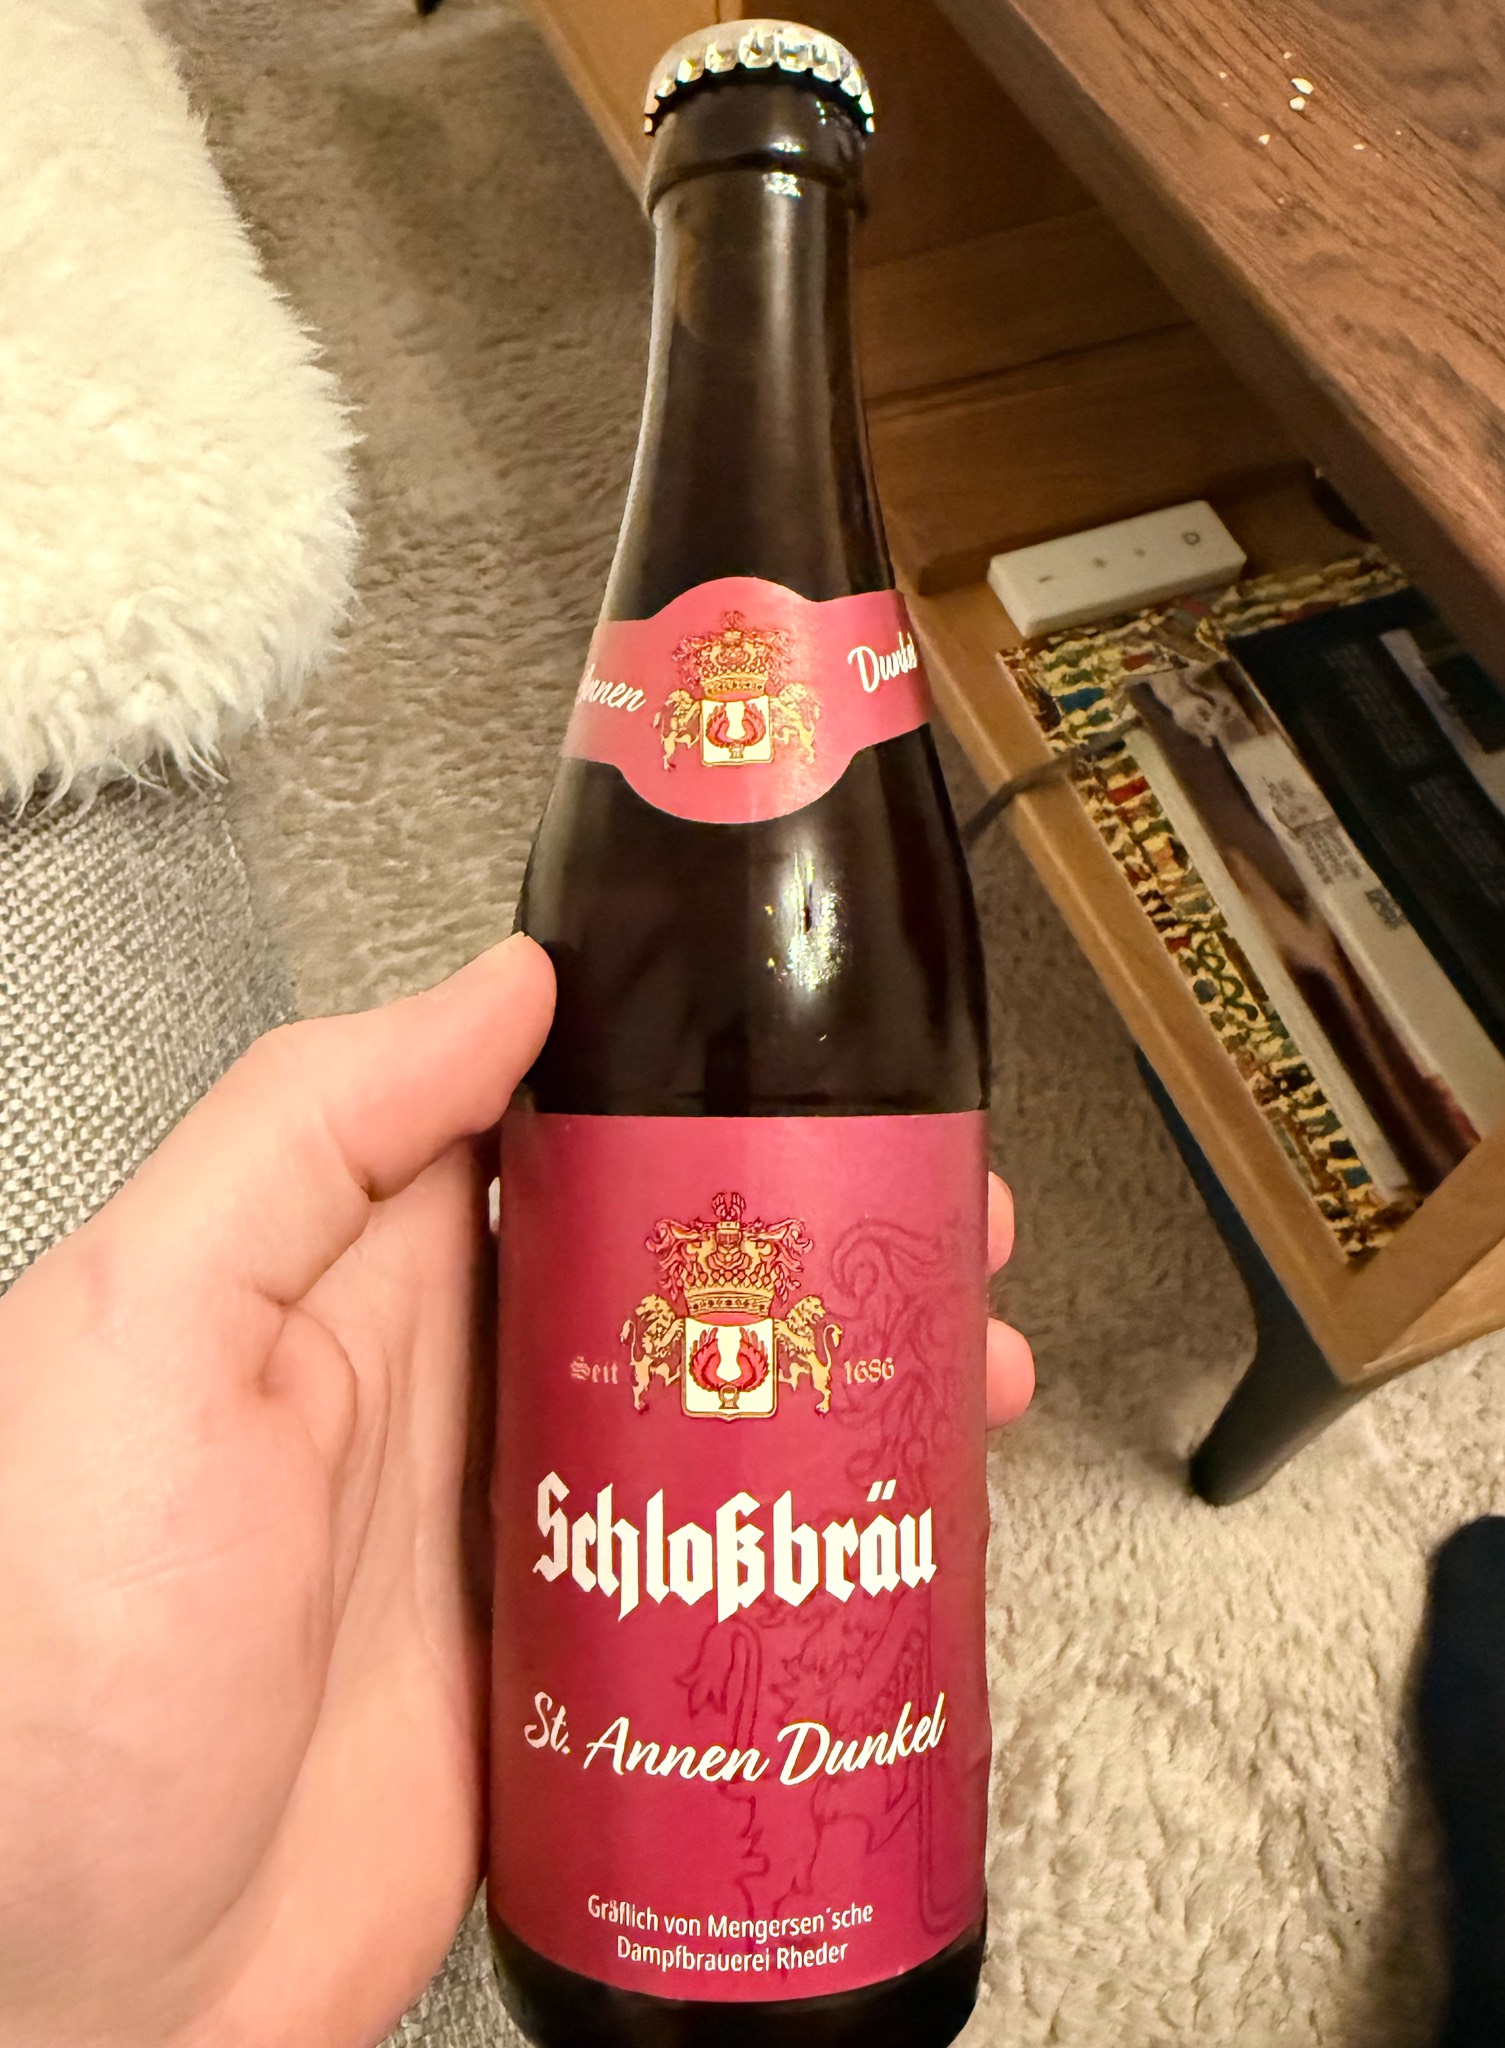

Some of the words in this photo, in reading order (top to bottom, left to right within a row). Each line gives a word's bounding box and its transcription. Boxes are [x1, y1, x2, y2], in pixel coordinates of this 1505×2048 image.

[570, 1356, 618, 1384] Seit
[843, 1357, 895, 1385] 1686
[532, 1471, 938, 1623] Schloßbräu
[524, 1691, 571, 1755] St.
[583, 1716, 770, 1783] Annen
[776, 1692, 948, 1786] Dunkel
[587, 1894, 658, 1932] Gräflich
[663, 1915, 700, 1937] von
[617, 1935, 770, 1973] Dampfbrauerei
[776, 1941, 848, 1970] Rheder
